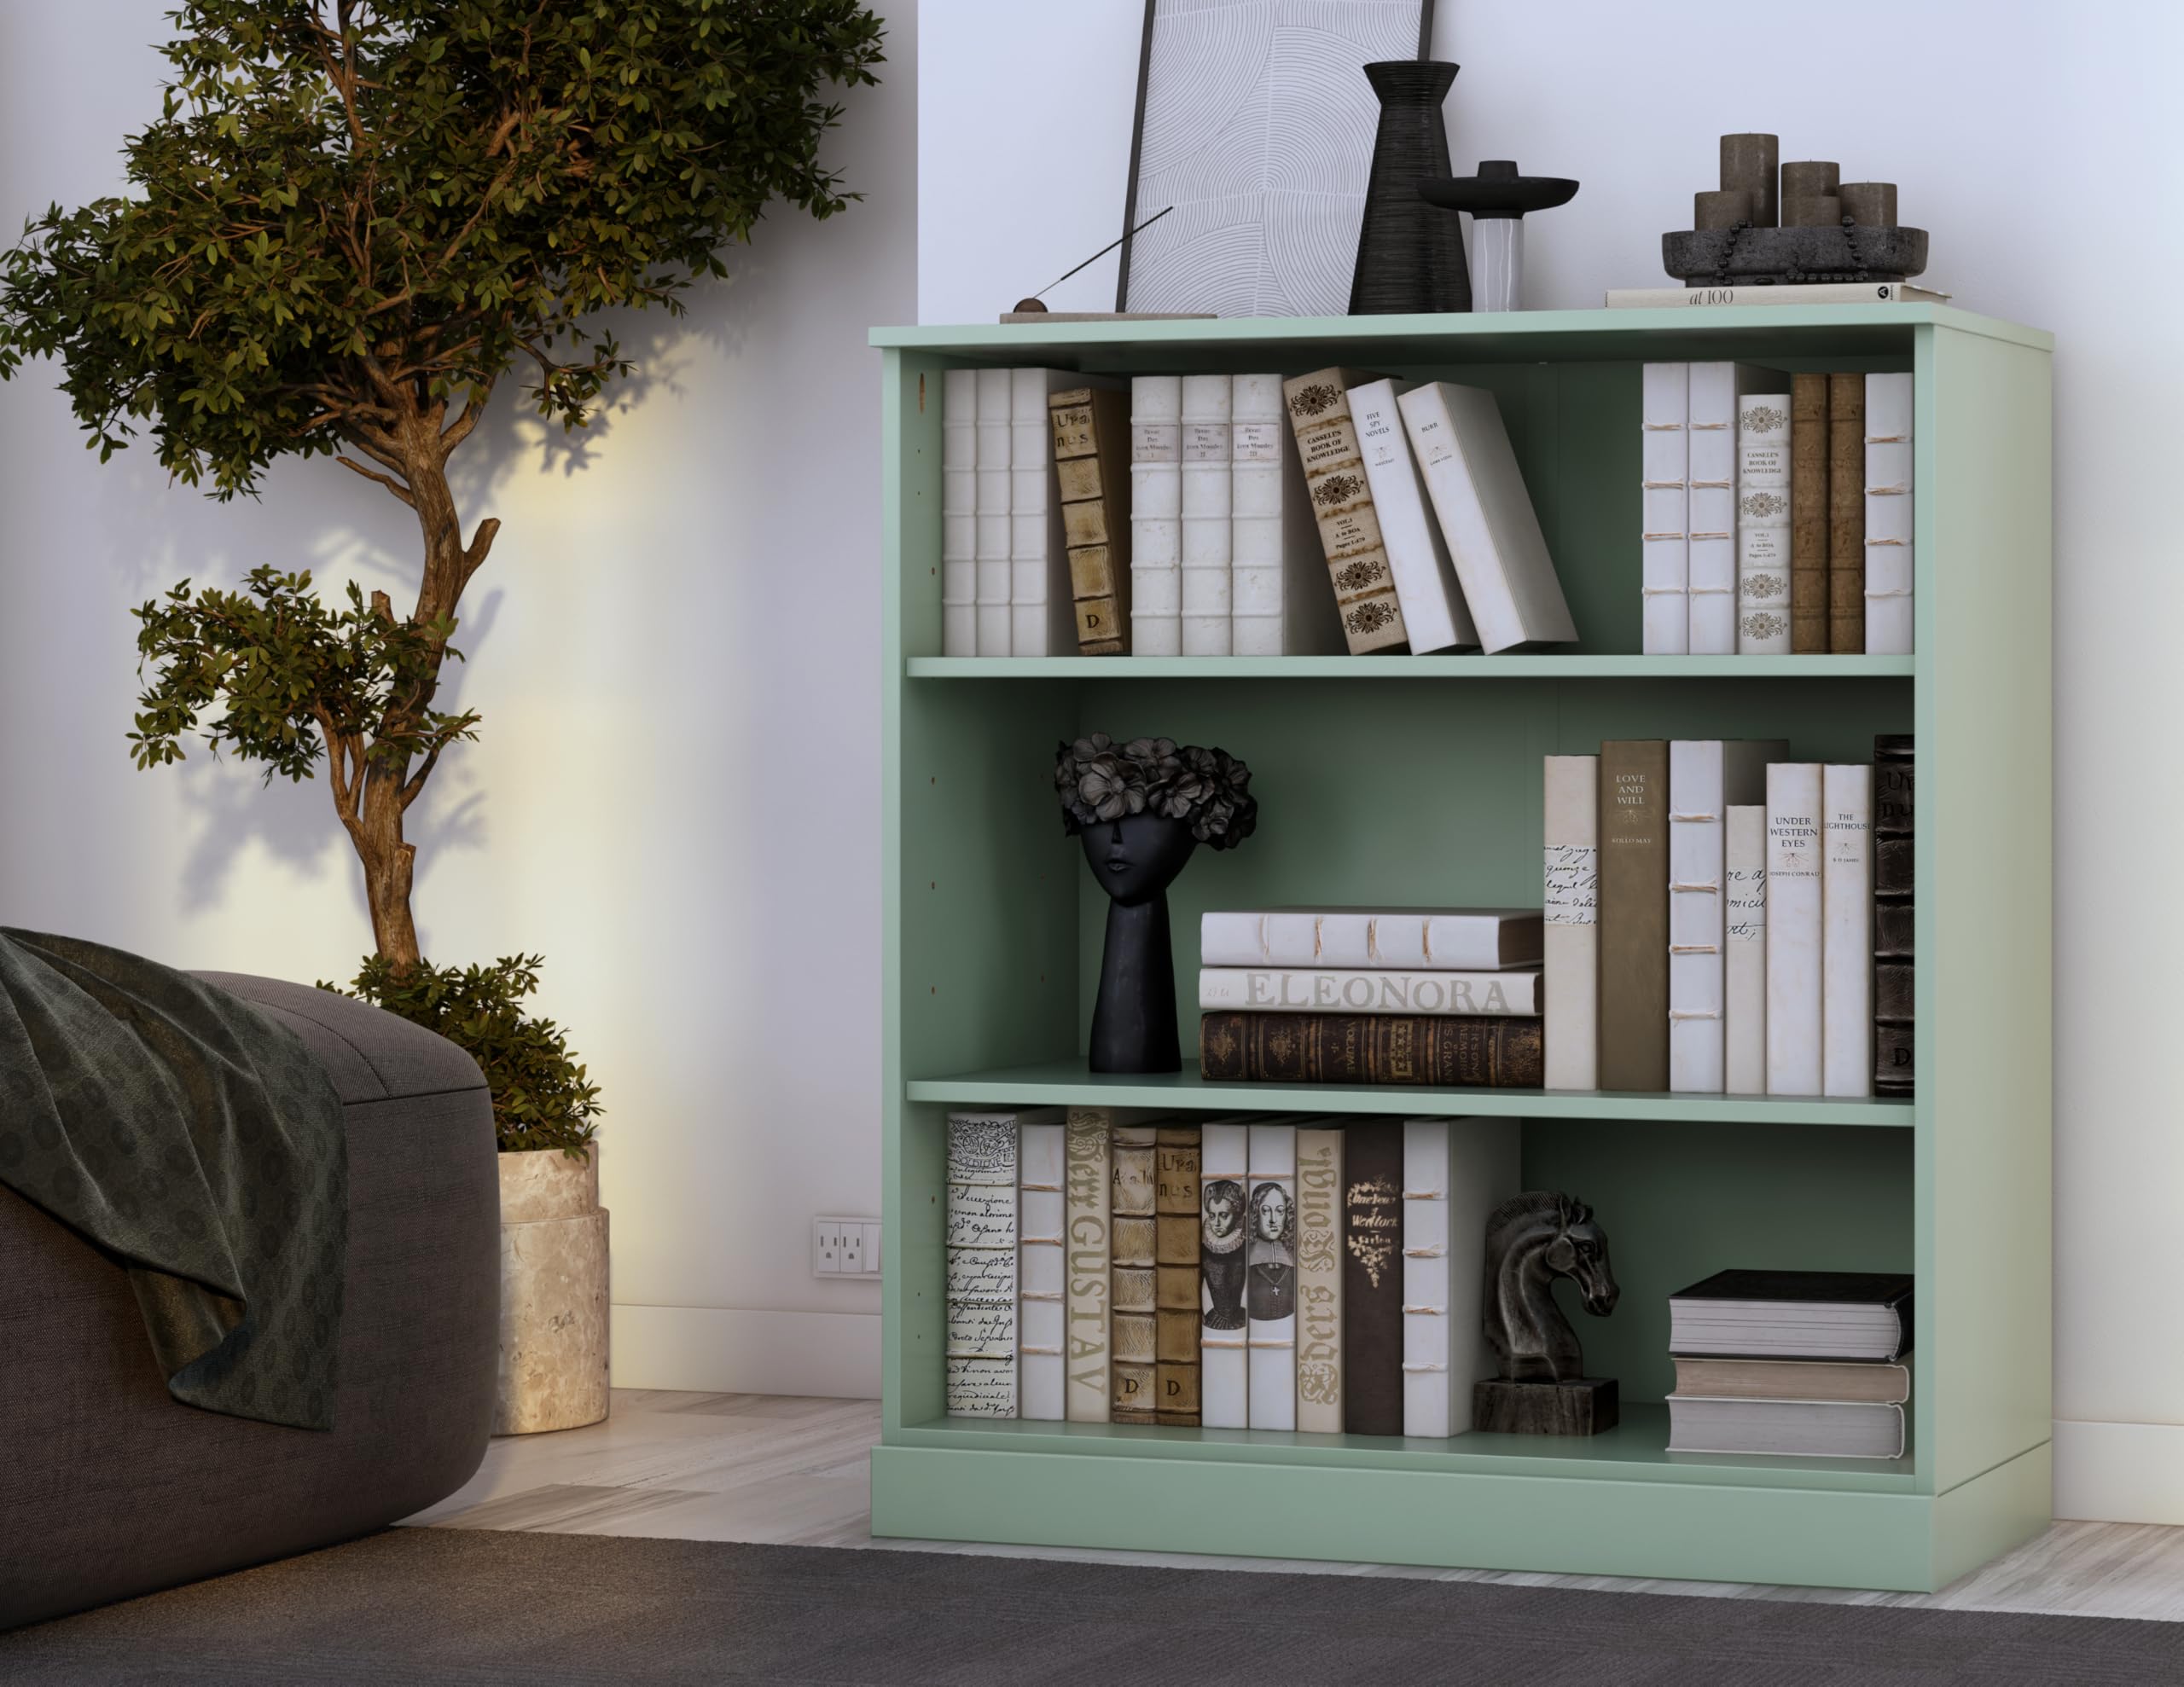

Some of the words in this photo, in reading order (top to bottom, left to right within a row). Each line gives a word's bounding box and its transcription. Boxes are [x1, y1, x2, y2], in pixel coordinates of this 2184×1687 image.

[1708, 289, 1734, 304] 100
[1366, 411, 1380, 420] FIVE
[1365, 426, 1390, 438] NOVELS
[1306, 445, 1350, 463] KNOWLEDGE
[1310, 443, 1332, 453] BOOK
[1085, 614, 1100, 629] D
[1616, 774, 1646, 783] LOVE
[1618, 786, 1644, 794] AND
[1775, 817, 1811, 826] UNDER
[1770, 828, 1818, 837] WESTERN
[1780, 839, 1806, 848] EYES
[1245, 972, 1512, 1014] ELEONORA
[1893, 1047, 1912, 1066] D
[1070, 1215, 1107, 1396] GUSTAV
[1125, 1378, 1139, 1393] D
[1166, 1379, 1181, 1396] D
